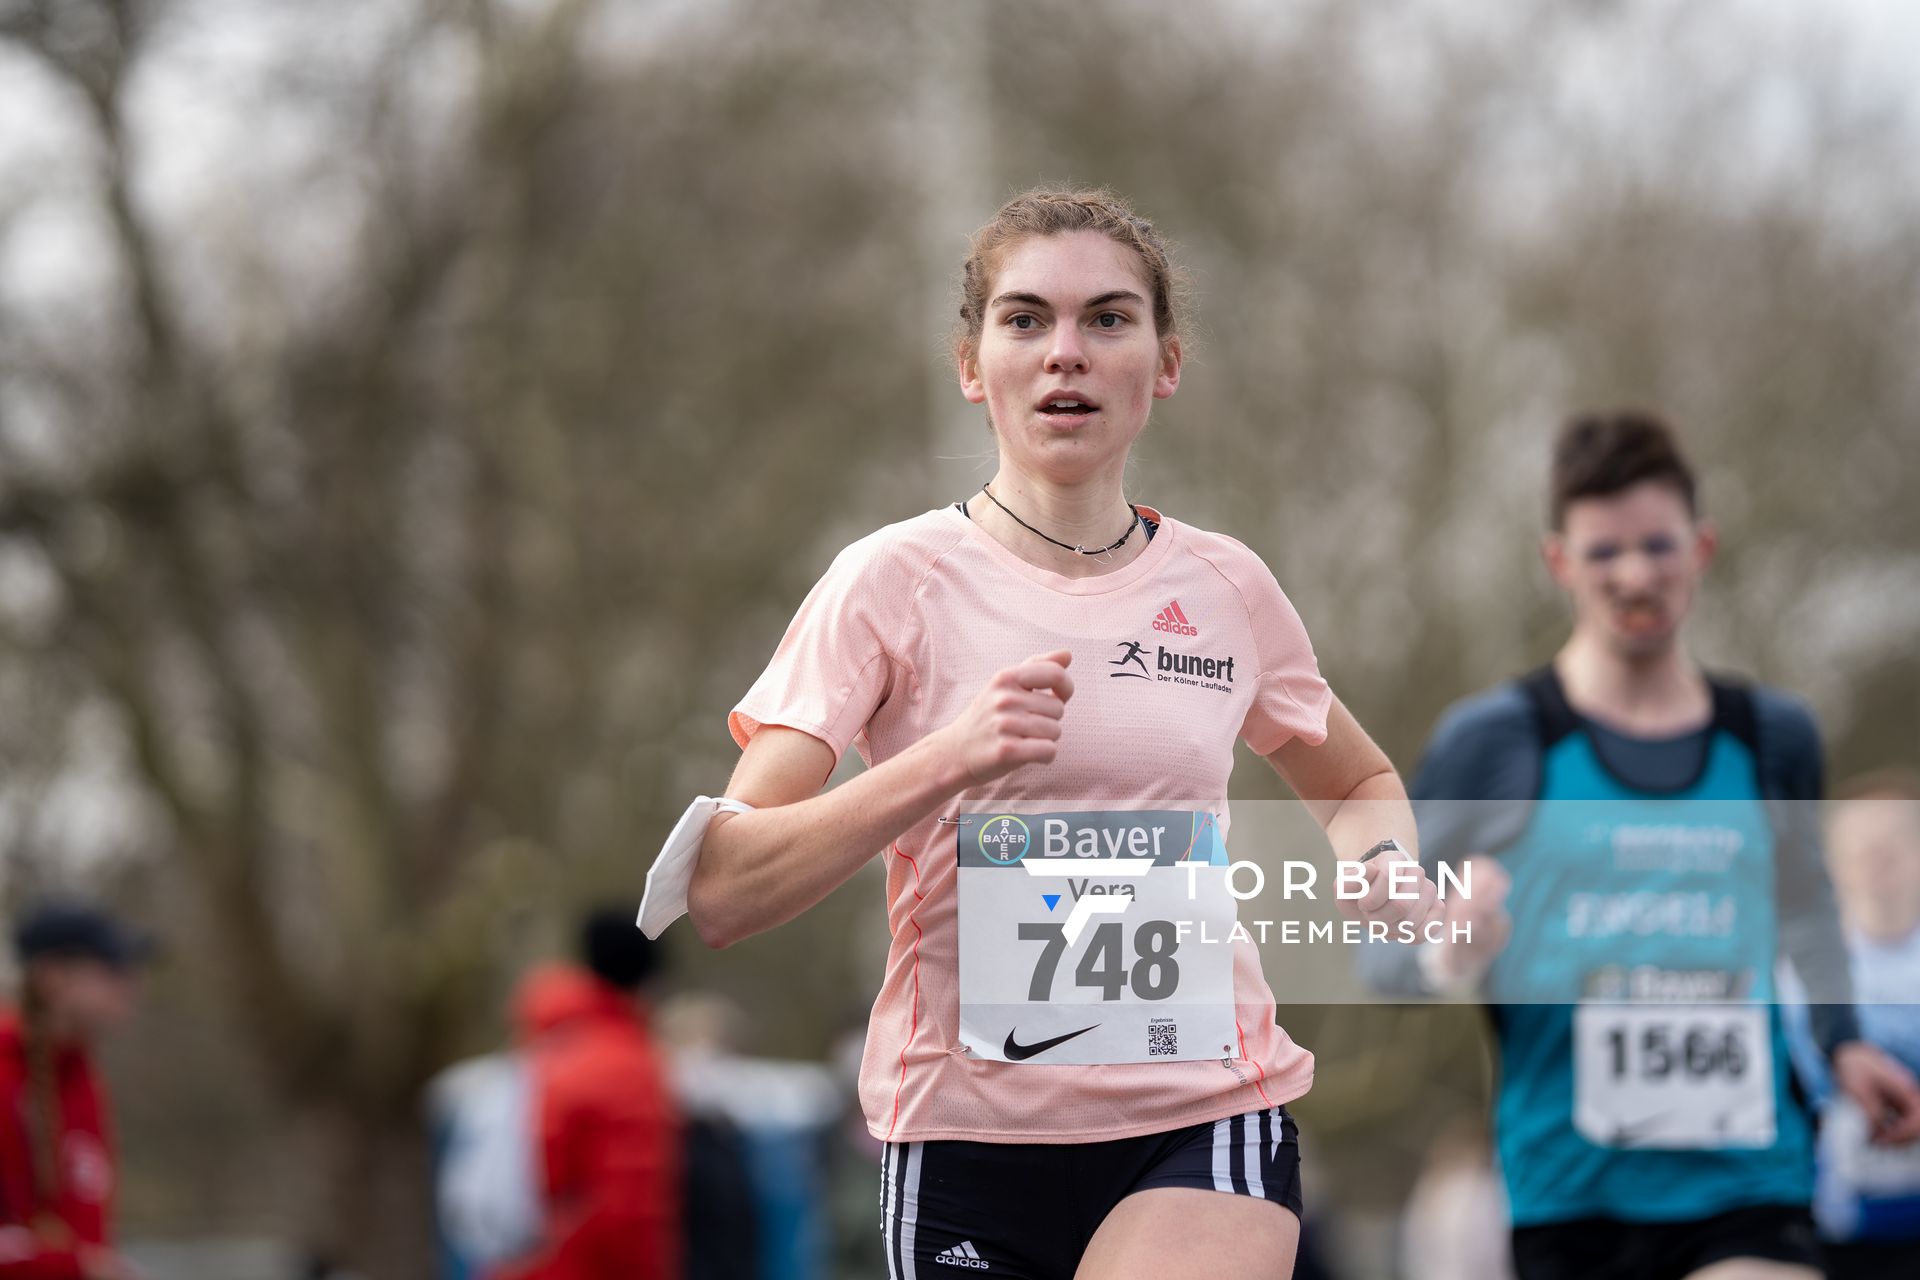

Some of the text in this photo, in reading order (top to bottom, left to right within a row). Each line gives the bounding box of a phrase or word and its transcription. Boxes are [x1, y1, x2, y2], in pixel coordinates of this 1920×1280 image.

[1152, 620, 1198, 636] adidas
[1157, 646, 1234, 682] bunert
[1174, 676, 1199, 687] Kölner
[1200, 681, 1232, 694] Laufladen
[983, 834, 1026, 843] BAYER
[1000, 819, 1010, 861] BAYER
[1043, 818, 1166, 860] Bayer
[1067, 878, 1136, 902] Vera
[1017, 920, 1180, 1001] 748
[1605, 1023, 1748, 1082] 1566
[935, 1254, 990, 1270] adidas
